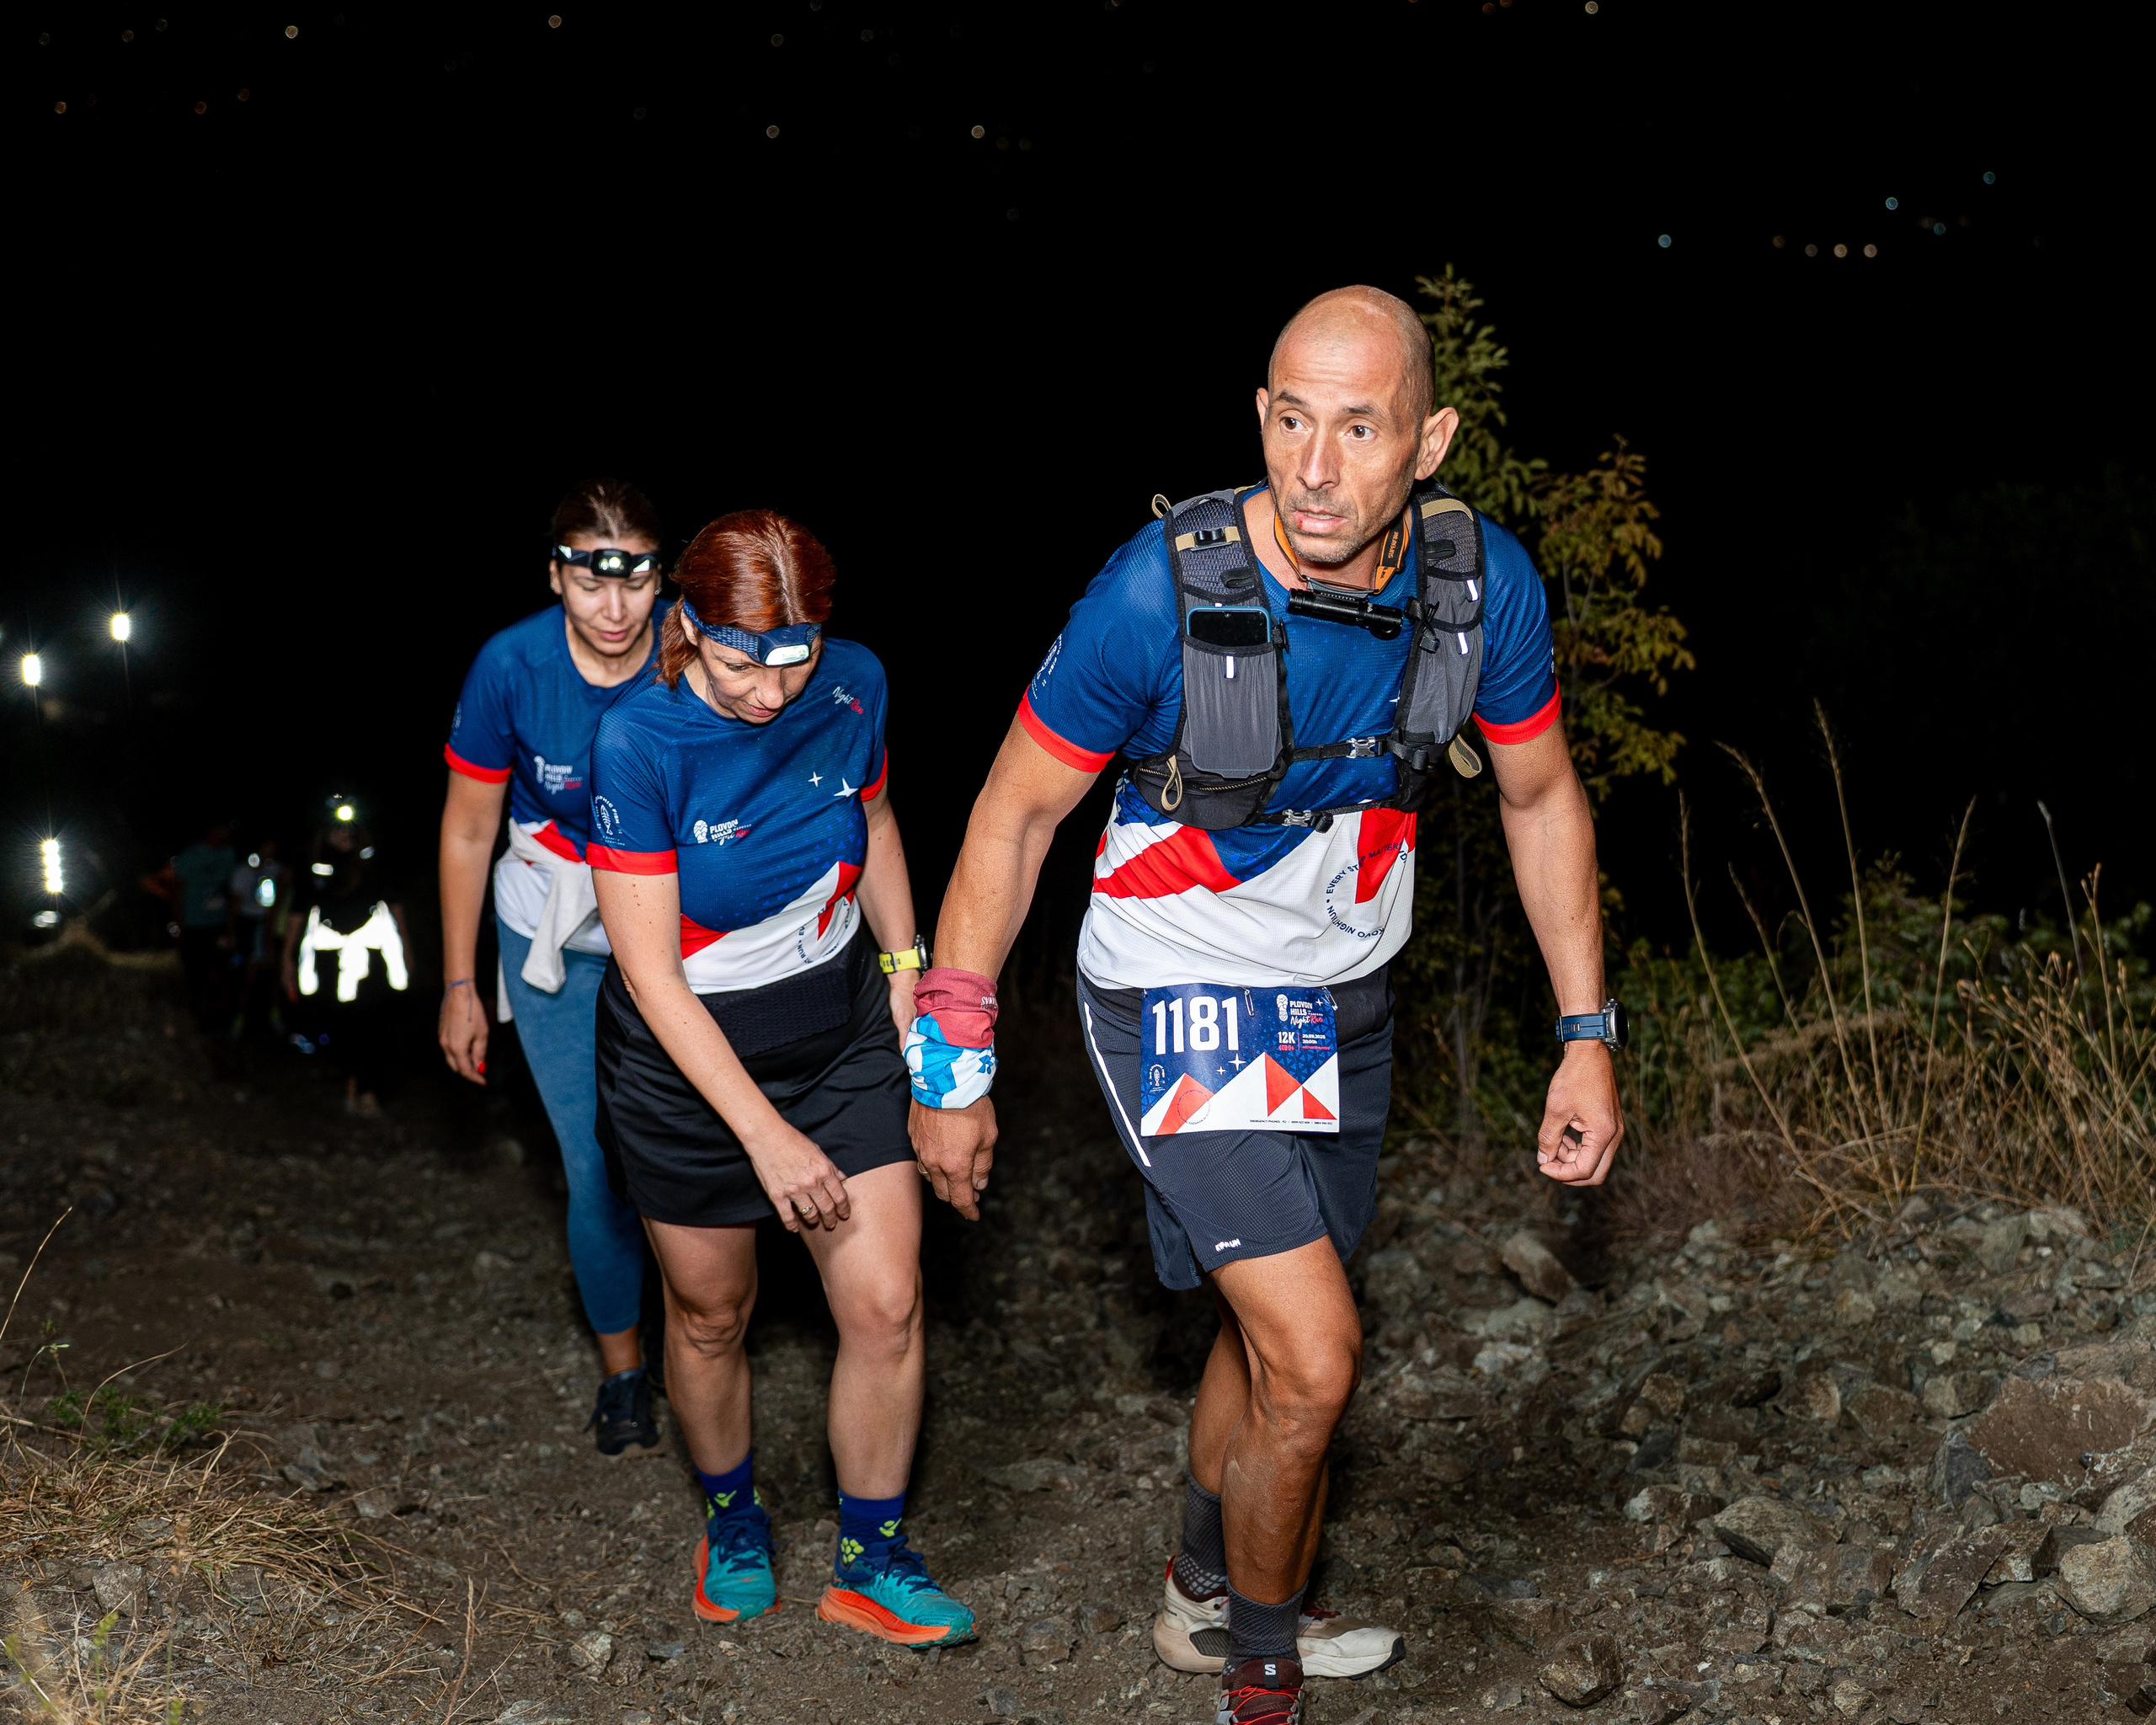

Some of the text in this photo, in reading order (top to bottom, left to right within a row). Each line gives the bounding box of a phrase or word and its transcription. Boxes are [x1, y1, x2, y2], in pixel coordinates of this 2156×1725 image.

[1326, 870, 1347, 895] EVERY
[1348, 855, 1366, 873] STEP
[1152, 996, 1239, 1055] 1181
[1290, 1016, 1310, 1029] Night
[1278, 1031, 1296, 1044] 12K
[1264, 1664, 1276, 1675] S
